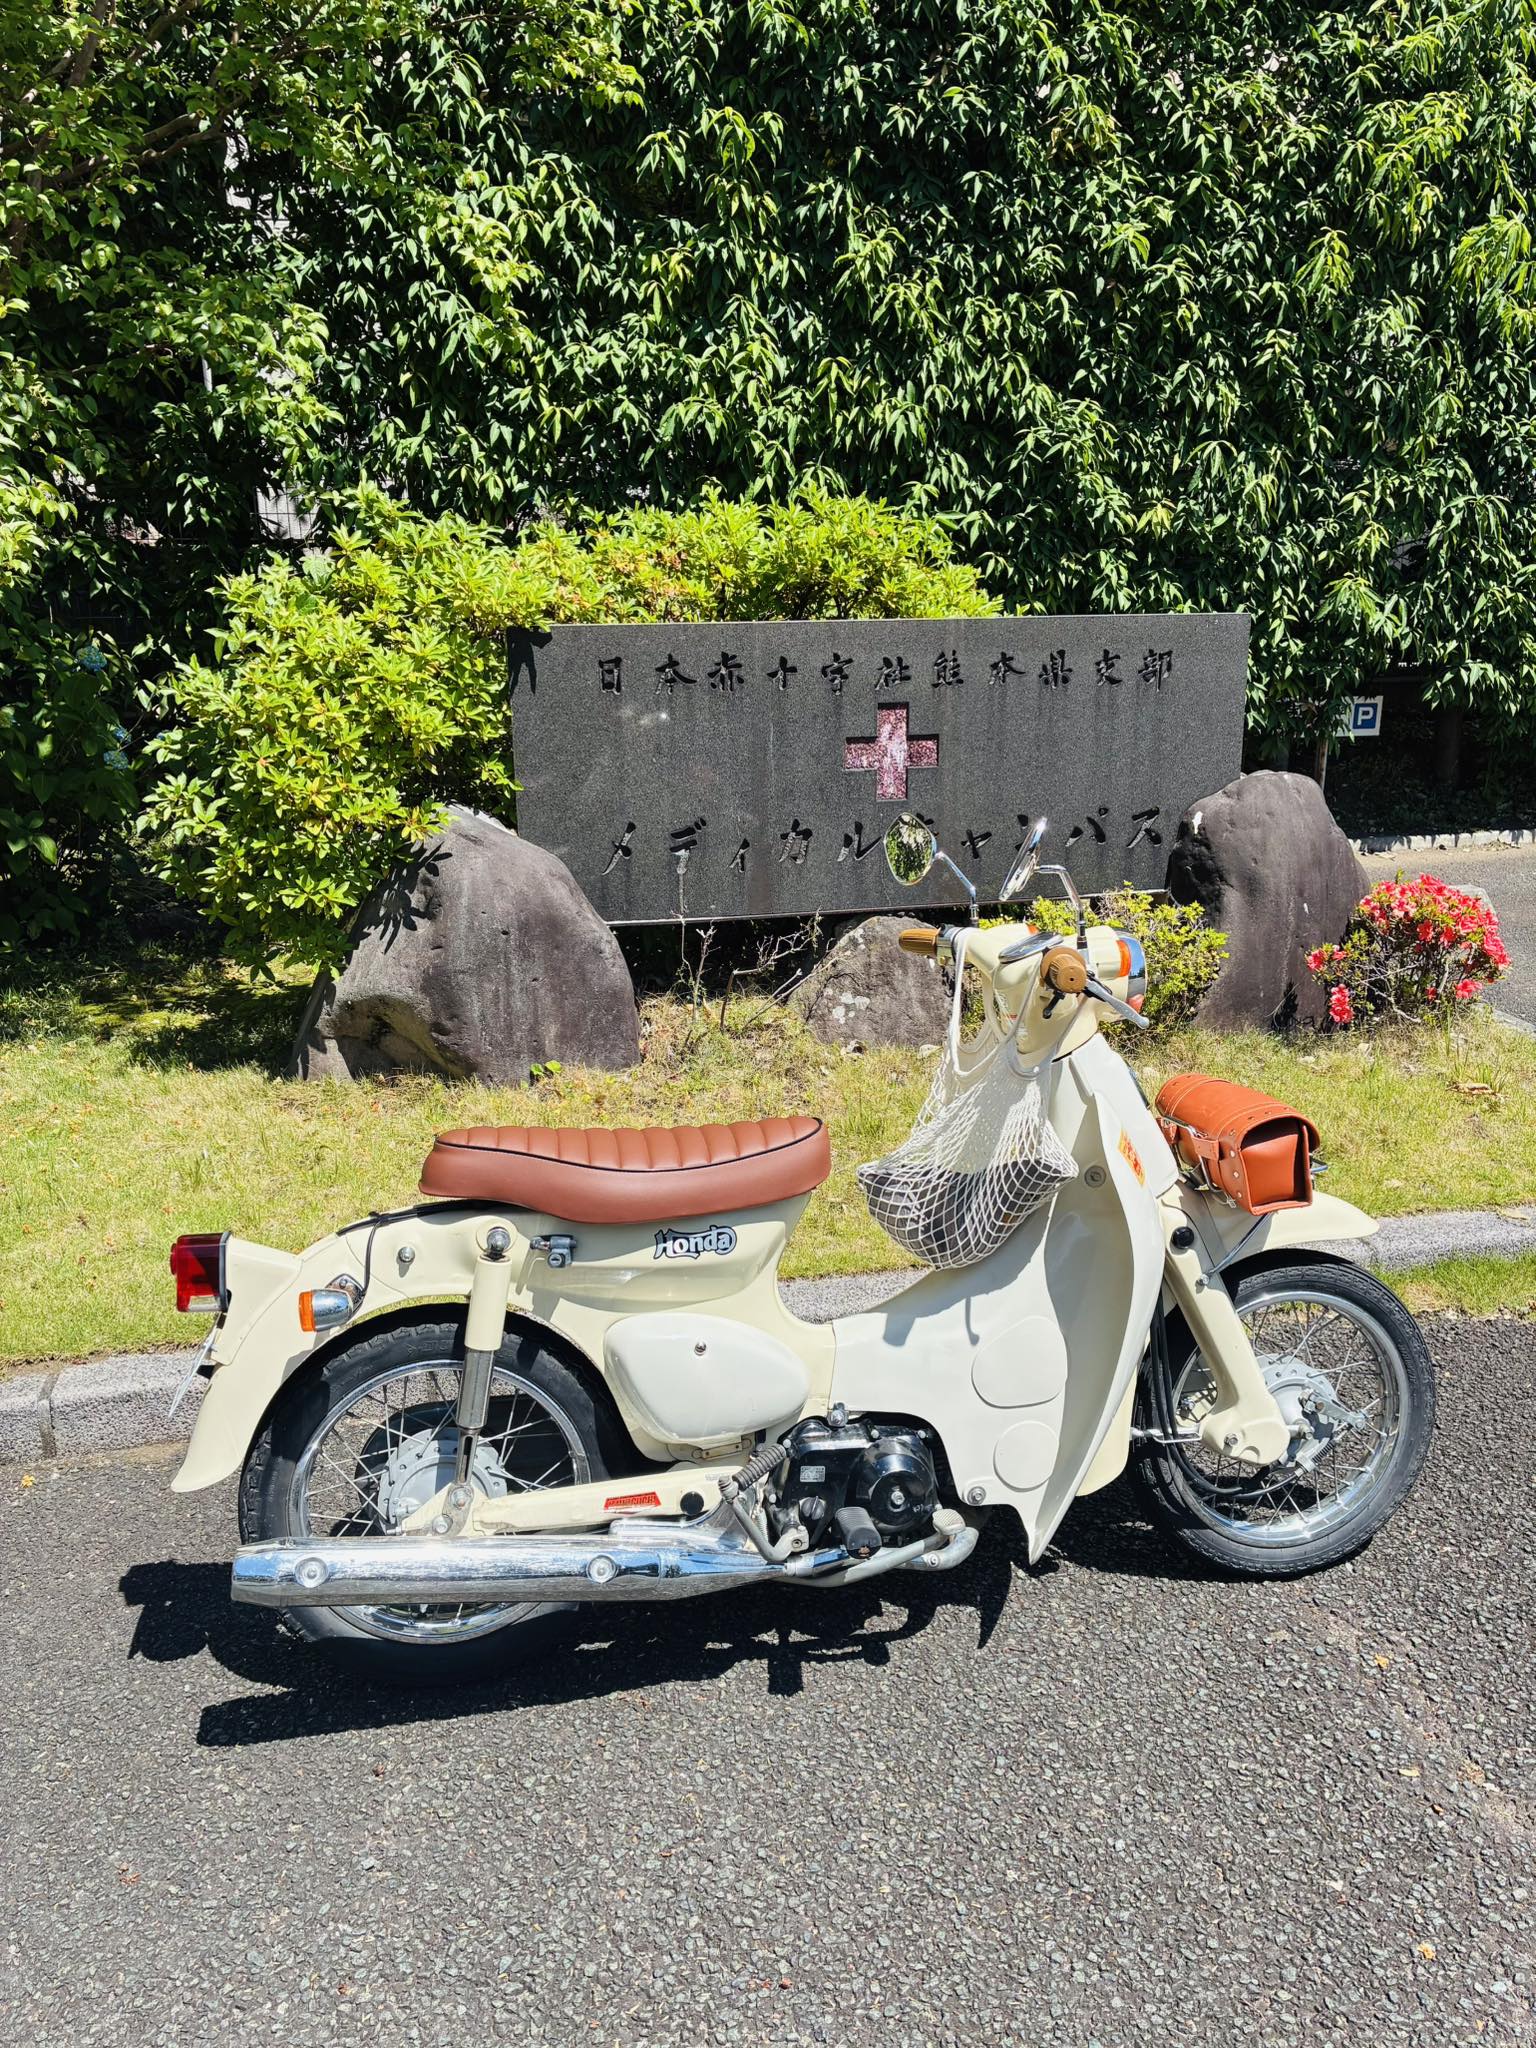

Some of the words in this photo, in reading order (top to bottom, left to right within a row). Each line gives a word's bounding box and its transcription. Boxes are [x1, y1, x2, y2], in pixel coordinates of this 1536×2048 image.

[599, 650, 1173, 695] 日本赤十字社熊本県支部
[1357, 706, 1374, 726] P
[602, 806, 1161, 876] メディカルャパス
[653, 1225, 737, 1259] Honda
